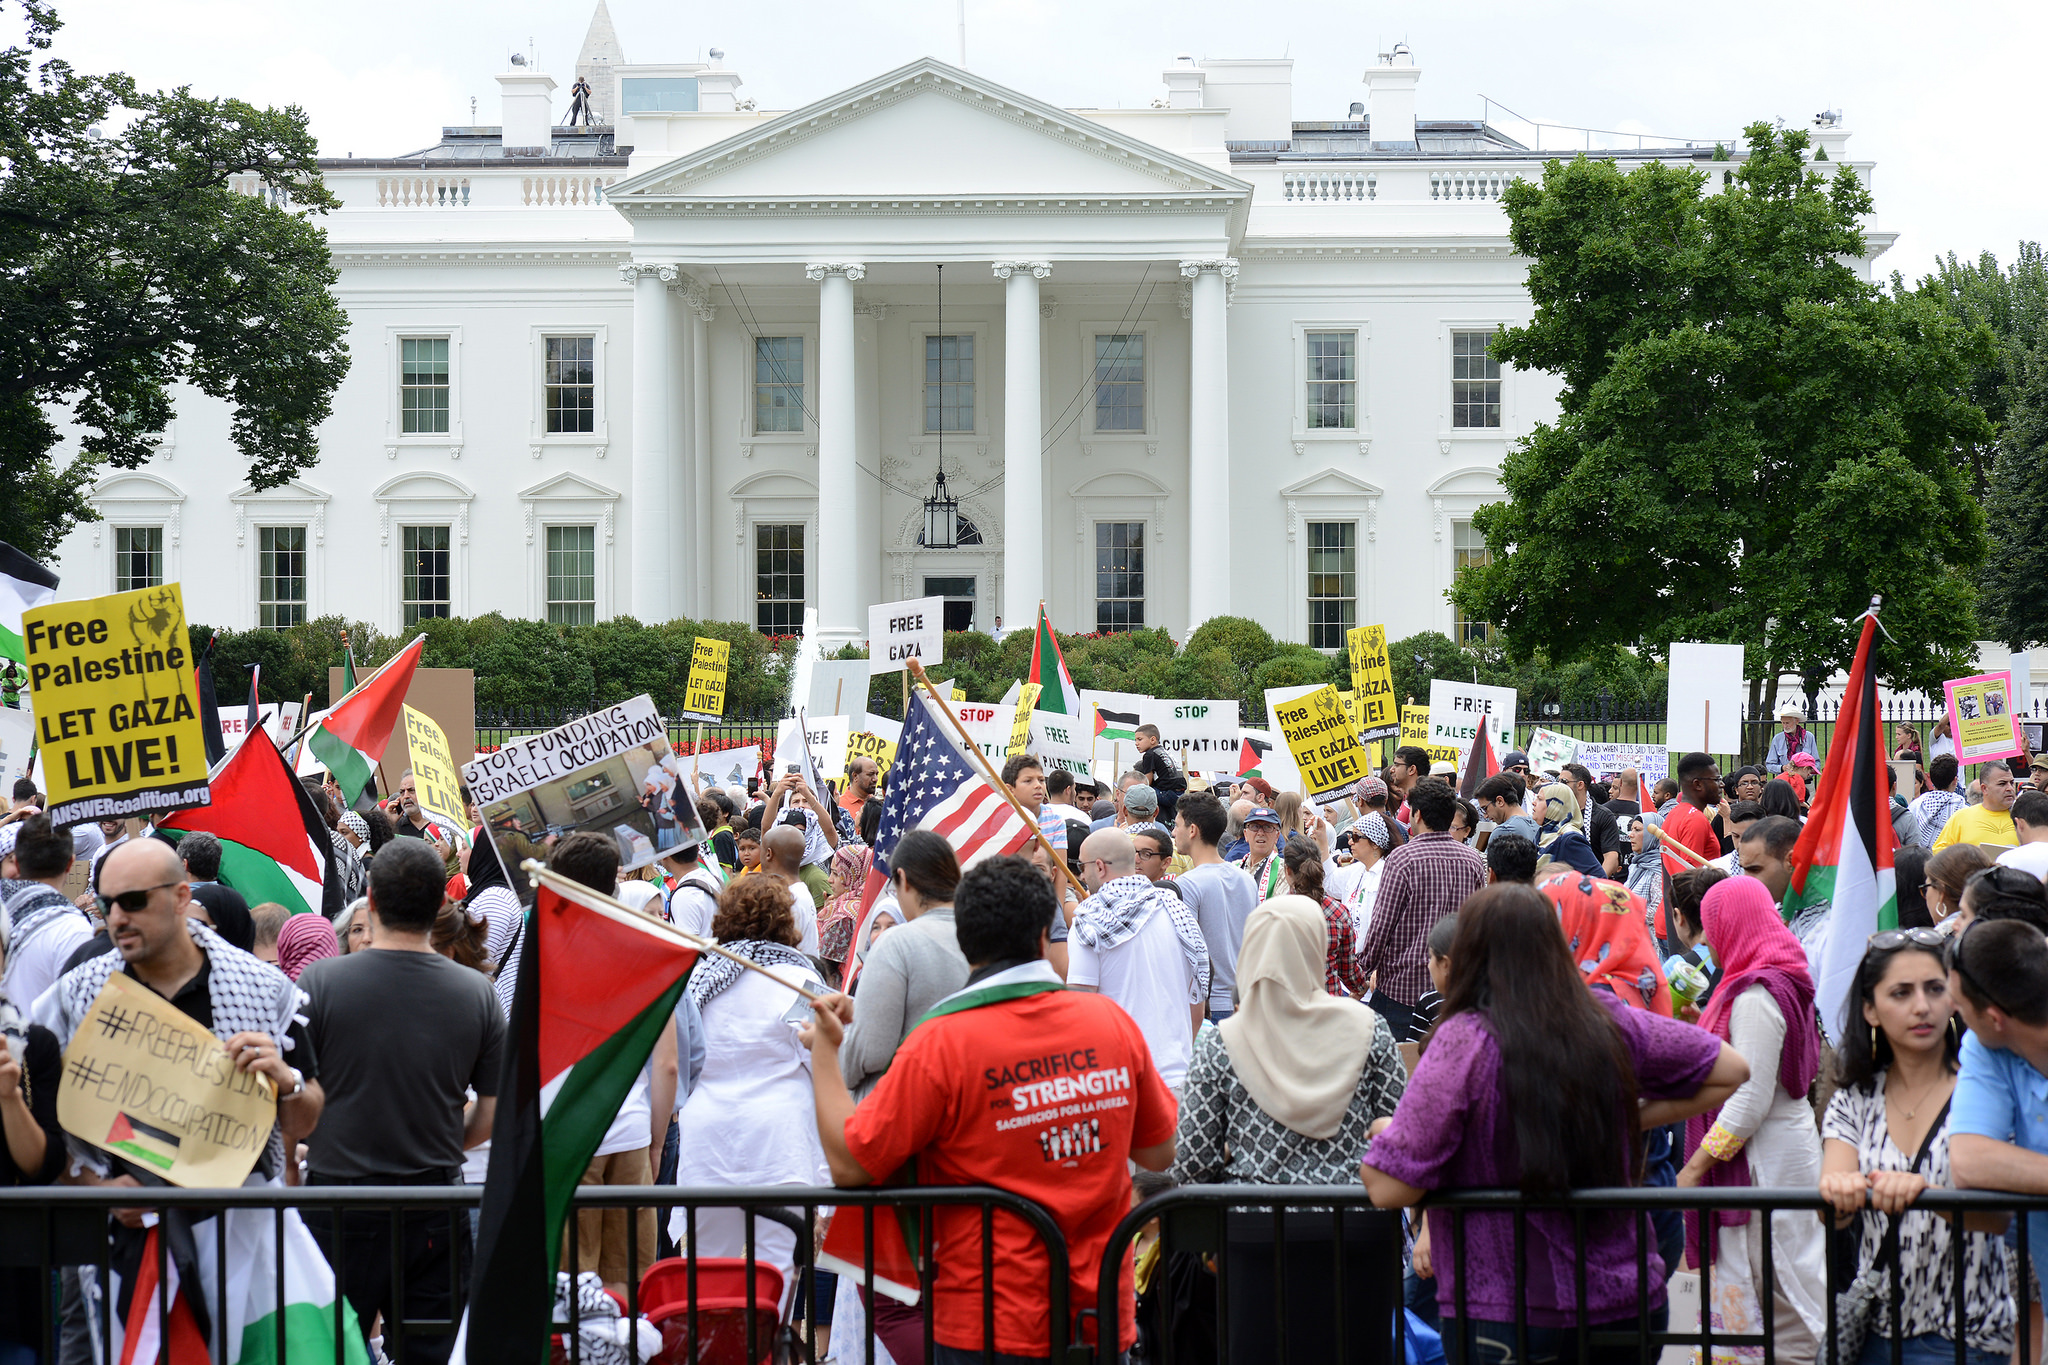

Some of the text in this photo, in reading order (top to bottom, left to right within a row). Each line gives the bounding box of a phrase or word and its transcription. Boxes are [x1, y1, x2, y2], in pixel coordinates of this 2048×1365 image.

[889, 614, 923, 634] FREE
[26, 618, 108, 654] Free
[694, 642, 713, 656] Free
[889, 642, 922, 660] GAZA
[31, 646, 185, 691] Palestine
[692, 657, 726, 673] Palestine
[689, 677, 724, 693] LET GAZA
[691, 692, 720, 711] LIVE!
[1175, 706, 1208, 718] STOP
[1454, 696, 1492, 714] FREE
[41, 693, 195, 744] LET GAZA
[960, 709, 994, 722] STOP
[1276, 707, 1308, 726] Free
[406, 711, 440, 744] Free
[807, 730, 828, 744] REE
[1044, 725, 1070, 745] FREE
[1284, 713, 1347, 744] Palestine
[465, 706, 628, 784] STOP FUNDING
[847, 733, 887, 754] STOP
[1162, 739, 1239, 751] CUPATION
[1295, 749, 1317, 767] LET
[1321, 734, 1359, 760] GAZA
[1602, 745, 1618, 753] WHEN
[1619, 744, 1627, 753] IT
[1627, 745, 1634, 754] IS
[1635, 745, 1646, 754] SAID
[1648, 746, 1655, 754] TO
[65, 735, 180, 789] LIVE!
[471, 713, 663, 807] ISRAELI OCCUPATION
[1043, 755, 1089, 776] PALESTINE
[1600, 754, 1615, 762] NOT
[1642, 763, 1652, 771] ARE
[1654, 764, 1667, 772] BUT
[414, 761, 440, 783] LET
[1308, 755, 1360, 788] LIVE!
[51, 786, 211, 828] ANSWERcoalition.org
[985, 1048, 1099, 1090] SACRIFICE
[1012, 1066, 1130, 1112] STRENGTH
[68, 1055, 269, 1152] #ENDOCCUPATION
[995, 1108, 1059, 1131] SACRIFICIOS
[1059, 1103, 1081, 1117] POR
[1082, 1101, 1095, 1113] LA
